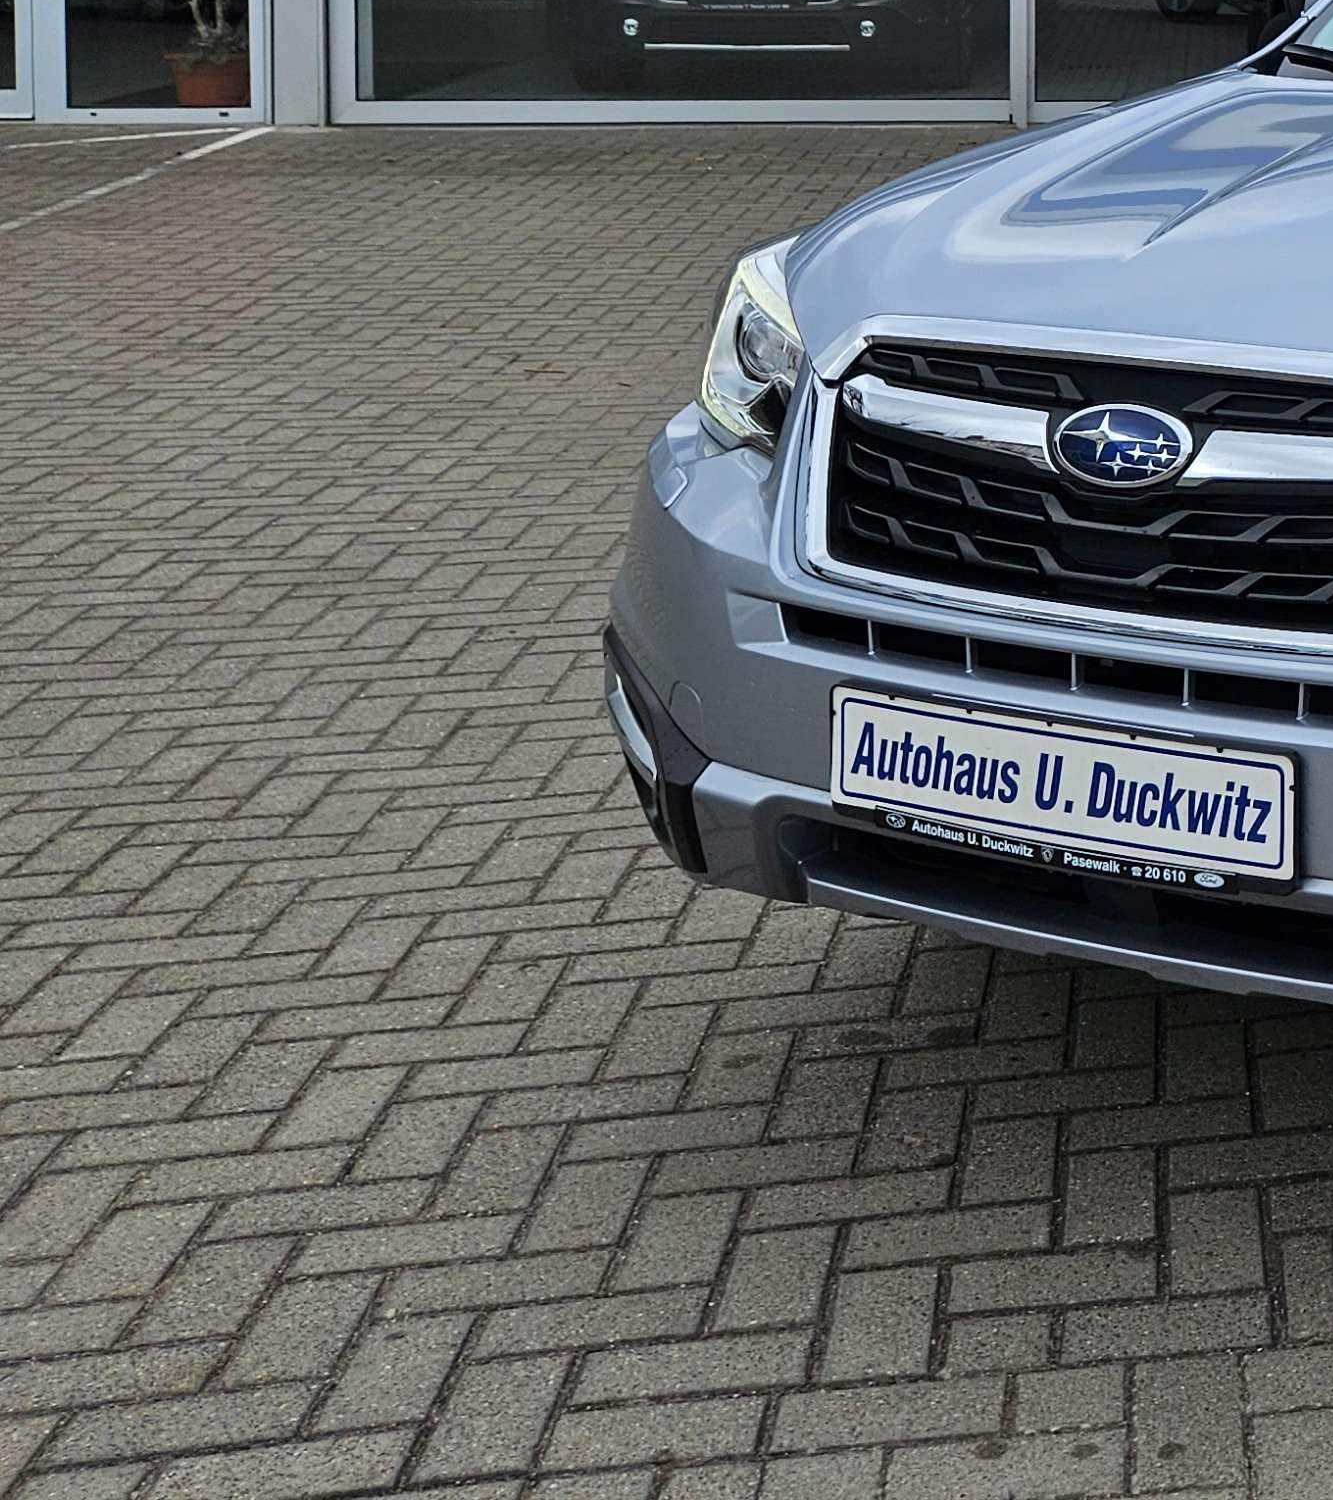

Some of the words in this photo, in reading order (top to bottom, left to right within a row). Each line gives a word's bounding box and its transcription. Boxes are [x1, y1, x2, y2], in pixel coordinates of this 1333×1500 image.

[851, 721, 1021, 804] Autohaus
[1034, 752, 1074, 814] U.
[1086, 761, 1273, 844] Duckwitz
[911, 819, 965, 844] Autohaus
[967, 832, 979, 846] U.
[982, 834, 1035, 858] Duckwitz
[1063, 852, 1120, 874] Pasewalk
[1145, 866, 1161, 880] 20
[1163, 868, 1186, 883] 610
